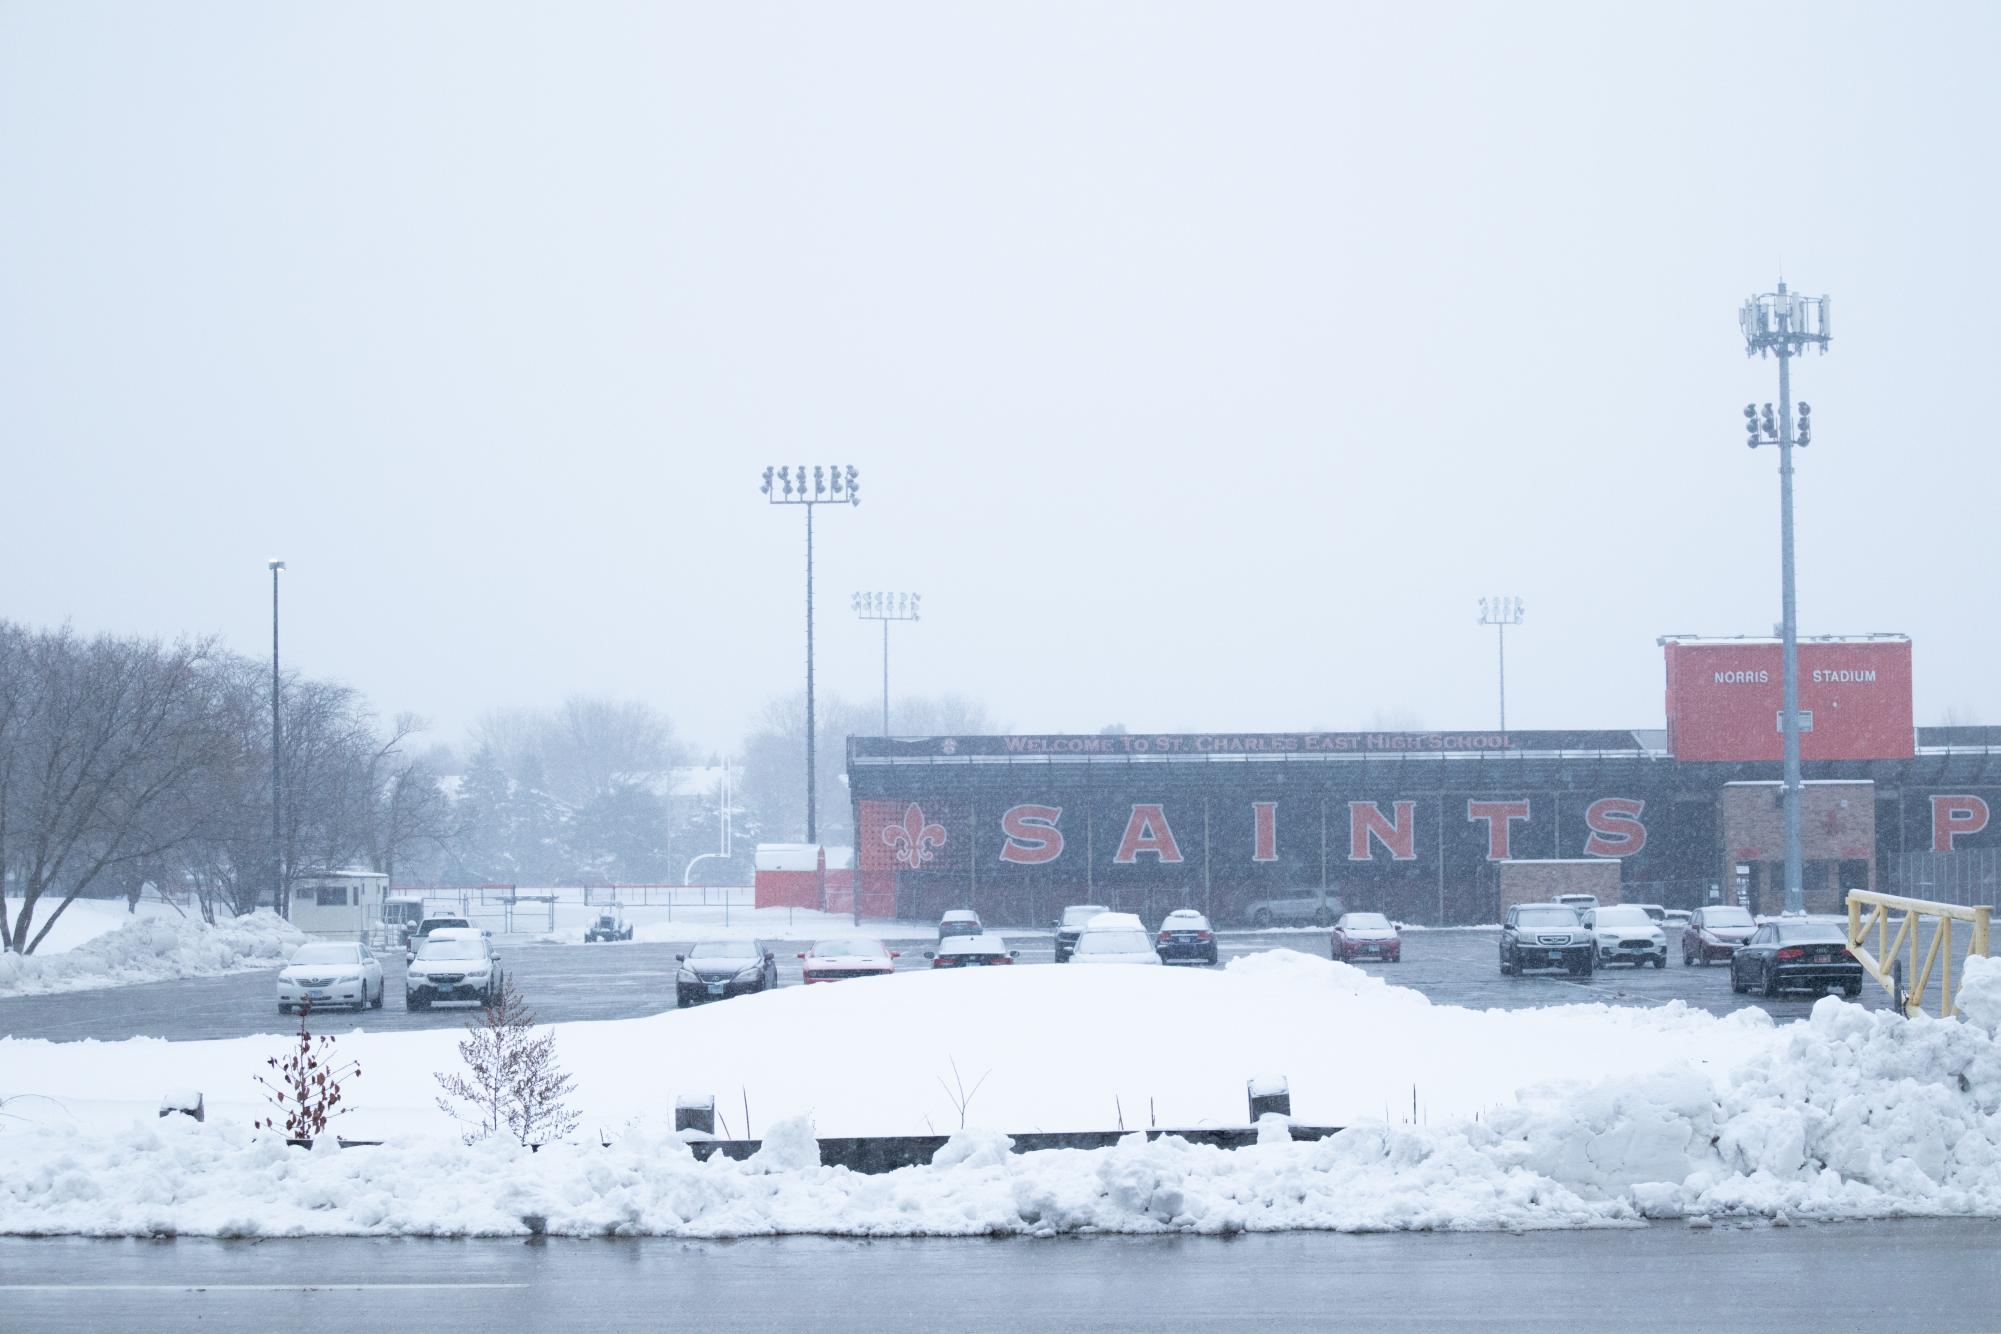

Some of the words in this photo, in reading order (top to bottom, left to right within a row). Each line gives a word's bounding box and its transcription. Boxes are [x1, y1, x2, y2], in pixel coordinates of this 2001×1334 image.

[1714, 671, 1768, 683] NORRIS
[1812, 670, 1876, 682] STADIUM
[1000, 798, 1647, 864] SAINTS
